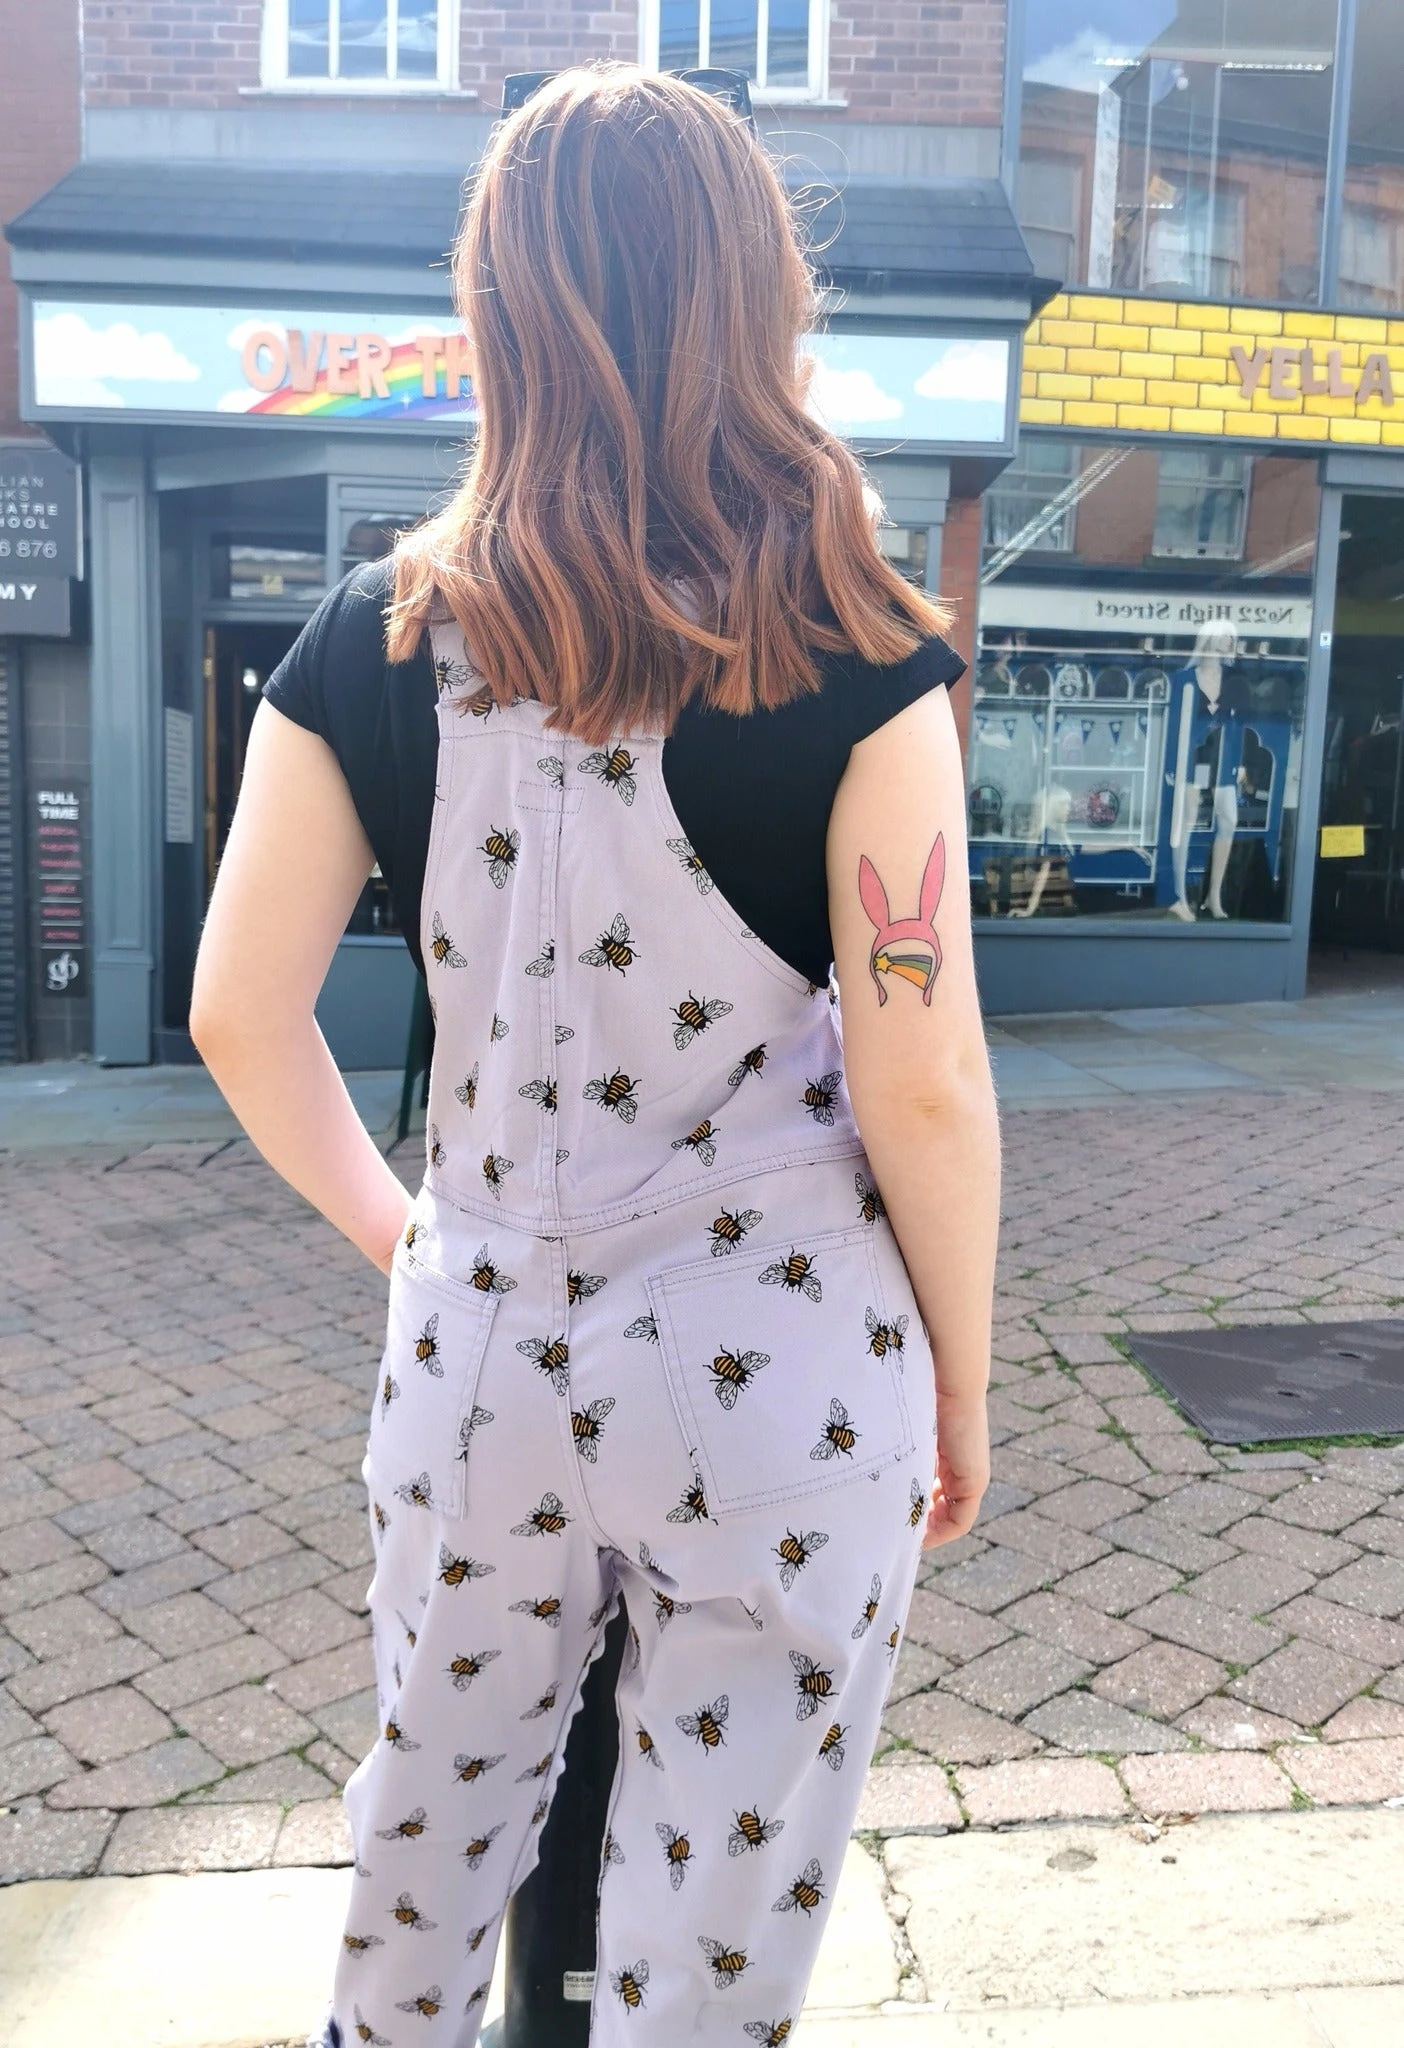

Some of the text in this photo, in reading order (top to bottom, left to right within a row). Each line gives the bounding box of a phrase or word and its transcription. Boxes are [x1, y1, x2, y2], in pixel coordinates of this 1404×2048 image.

[242, 329, 391, 399] OVER
[1230, 345, 1394, 406] YELLA
[38, 791, 79, 805] FULL
[39, 806, 79, 820] TIME
